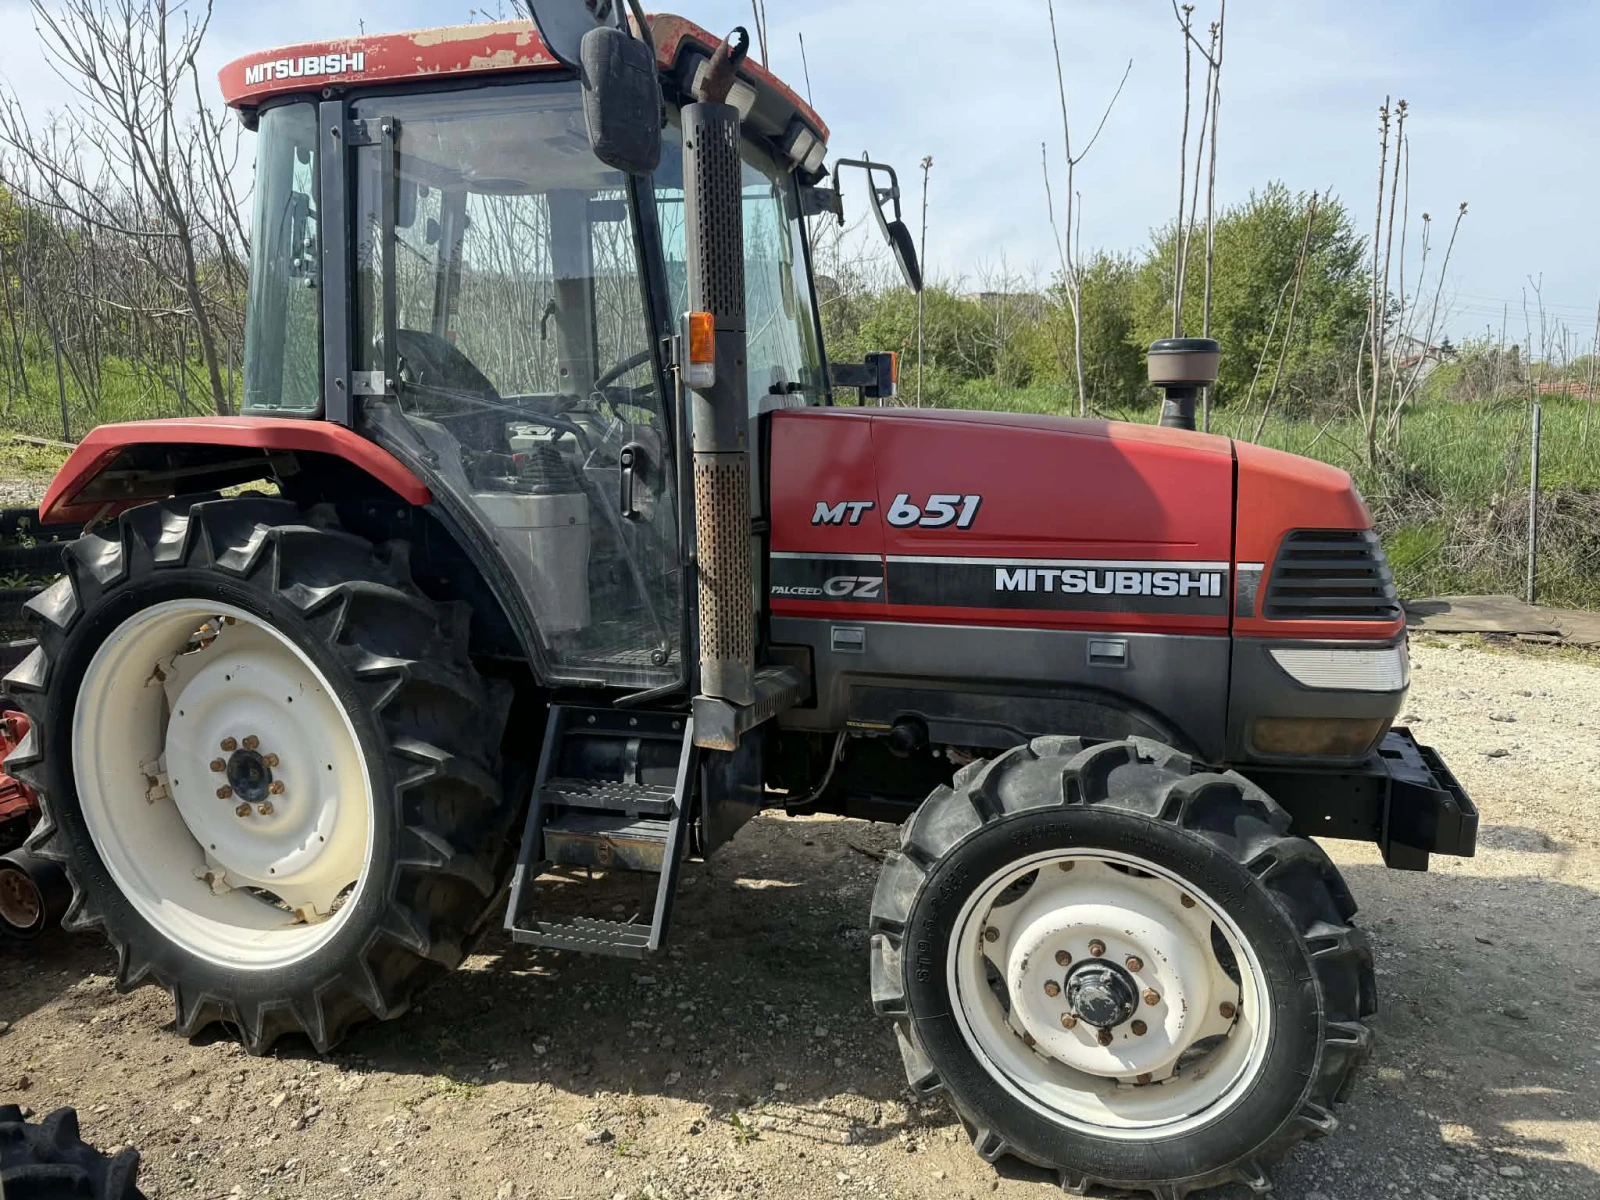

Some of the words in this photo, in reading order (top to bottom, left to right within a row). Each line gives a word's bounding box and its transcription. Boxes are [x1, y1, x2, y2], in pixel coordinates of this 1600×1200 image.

[244, 51, 366, 86] MITSUBISHI
[811, 500, 875, 526] MT
[886, 493, 983, 530] 651
[771, 585, 823, 596] PALCEED
[822, 575, 884, 598] GZ
[994, 567, 1222, 597] MITSUBISHI
